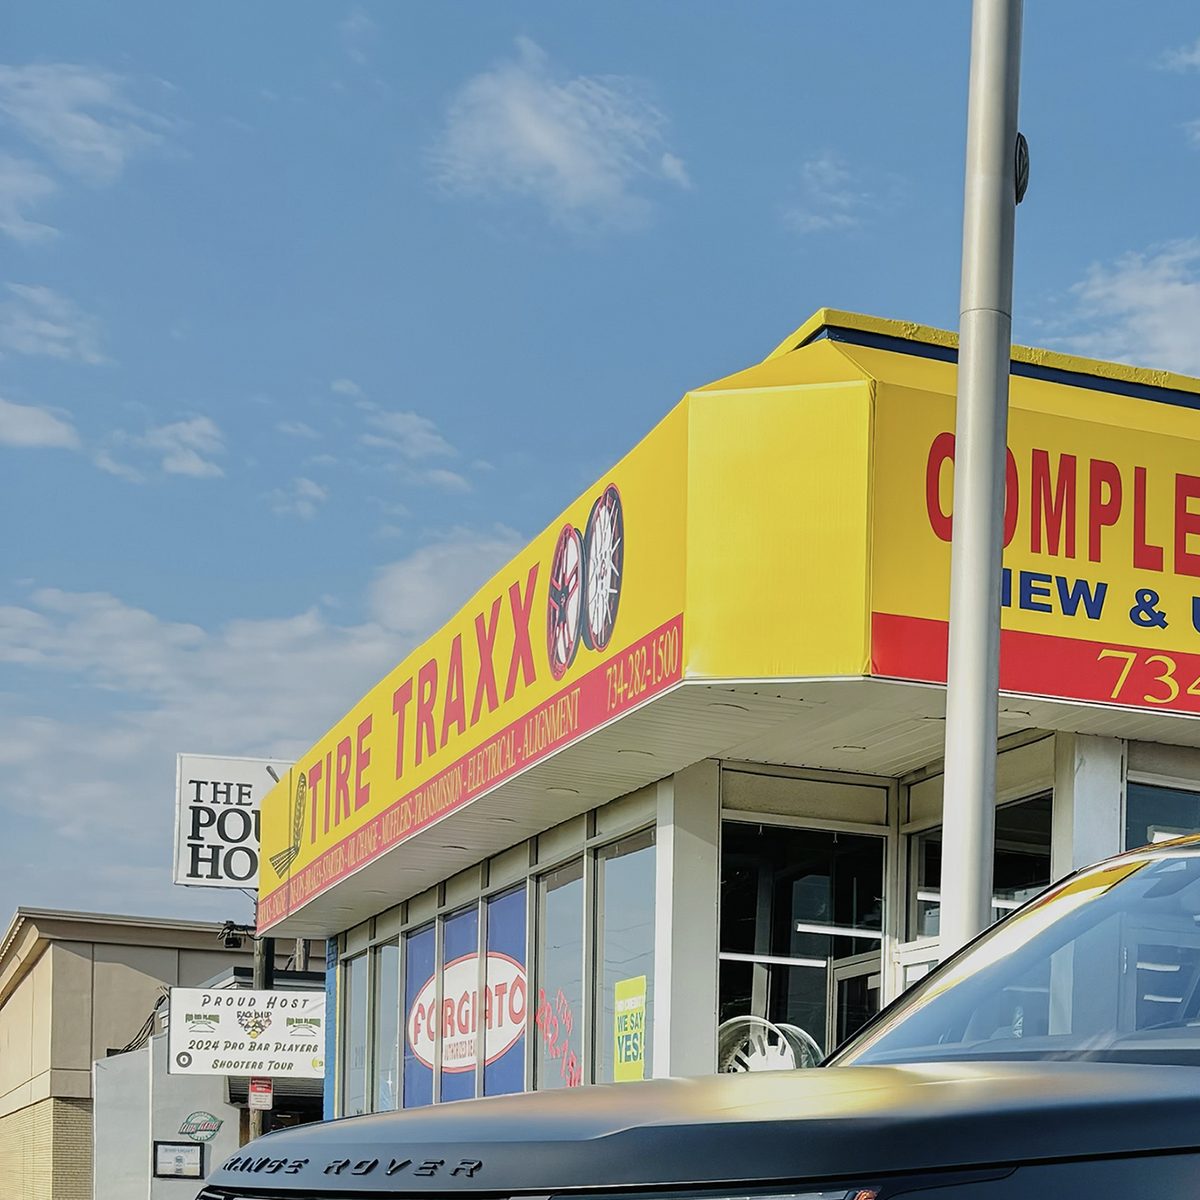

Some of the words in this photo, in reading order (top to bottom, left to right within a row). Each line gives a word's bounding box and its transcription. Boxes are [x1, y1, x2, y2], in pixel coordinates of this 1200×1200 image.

[1128, 588, 1168, 630] &
[606, 626, 679, 712] 734-282-1500
[308, 713, 373, 845] TIRE
[392, 561, 540, 780] TRAXX
[468, 730, 516, 793] ELECTRICAL
[522, 688, 580, 760] ALIGNMENT
[188, 779, 253, 806] THE
[186, 843, 259, 881] HO
[201, 994, 256, 1007] PROUD
[266, 996, 310, 1009] HOST
[617, 1014, 628, 1033] WE
[629, 1011, 643, 1031] SAY
[188, 1040, 220, 1051] 2024
[223, 1041, 245, 1051] PRO
[248, 1041, 271, 1052] BAR
[274, 1042, 319, 1053] PLAYERS
[617, 1031, 643, 1063] YES!
[212, 1059, 263, 1071] SHOOTERS
[267, 1060, 294, 1071] TOUR
[323, 1158, 483, 1178] ROVER
